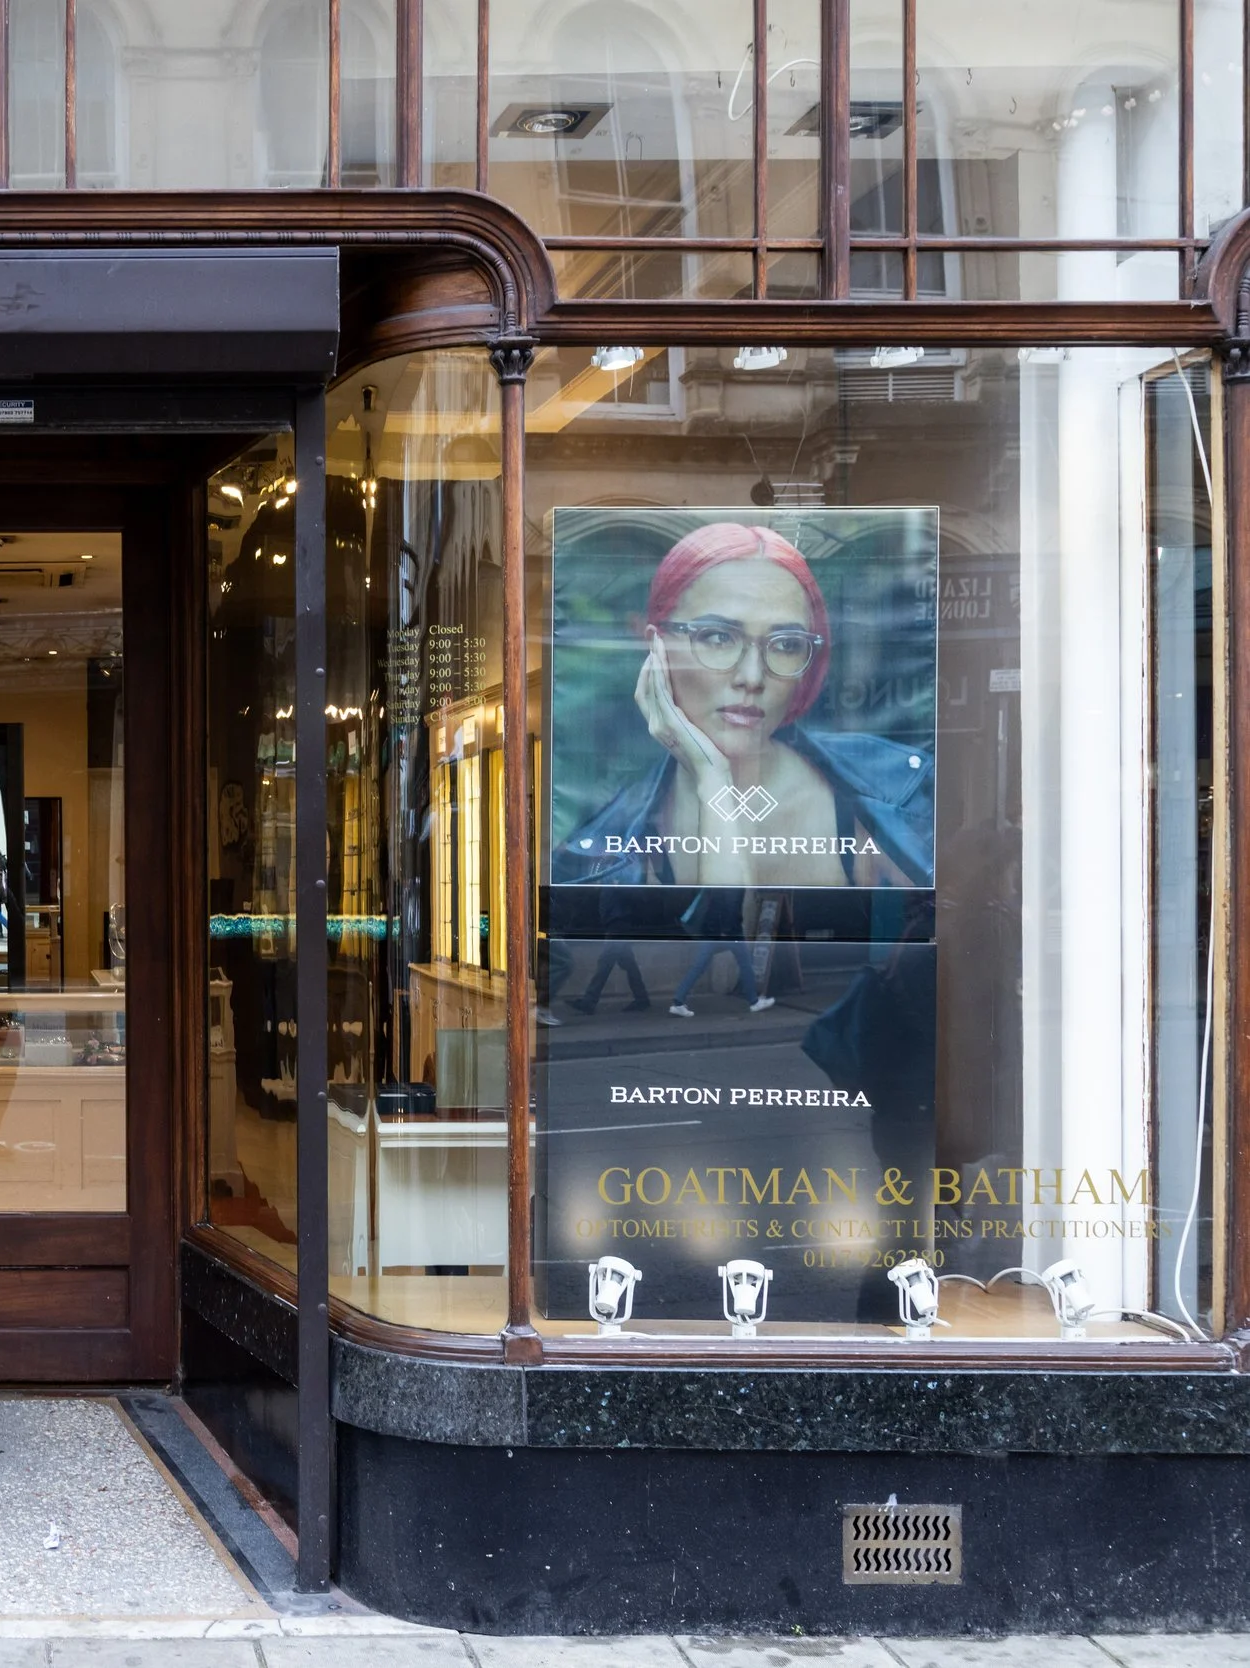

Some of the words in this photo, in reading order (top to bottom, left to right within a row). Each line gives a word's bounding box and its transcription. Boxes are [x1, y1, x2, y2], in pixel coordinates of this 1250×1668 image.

[387, 628, 420, 639] Monday
[429, 624, 463, 635] Closed
[387, 642, 420, 653] Tuesday
[429, 639, 451, 649] 9:00
[463, 638, 486, 648] 5:30
[377, 656, 420, 668] Wednesday
[429, 653, 451, 663] 9:00
[463, 652, 486, 662] 5:30
[384, 671, 420, 682] Thurday
[429, 668, 451, 678] 9:00
[463, 667, 486, 677] 5:30
[430, 683, 452, 693] 9:00
[464, 682, 486, 692] 5:30
[386, 700, 421, 711] Saturday
[430, 697, 452, 707] 9:00
[390, 713, 421, 725] Sunday
[430, 711, 457, 722] Clos
[605, 836, 721, 854] BARTON
[731, 836, 881, 855] PERREIRA
[610, 1086, 721, 1104] BARTON
[730, 1088, 871, 1108] PERREIRA
[598, 1166, 860, 1206] GOATMAN
[876, 1166, 914, 1206] &
[930, 1167, 1150, 1206] BATHAM
[576, 1219, 758, 1239] OPTOMETRISTS
[765, 1219, 784, 1238] &
[791, 1219, 906, 1239] CONTACT
[912, 1219, 973, 1239] LENS
[981, 1219, 1173, 1239] PRACTITIONERS
[804, 1249, 855, 1268] 0117
[861, 1248, 945, 1268] 9262380
